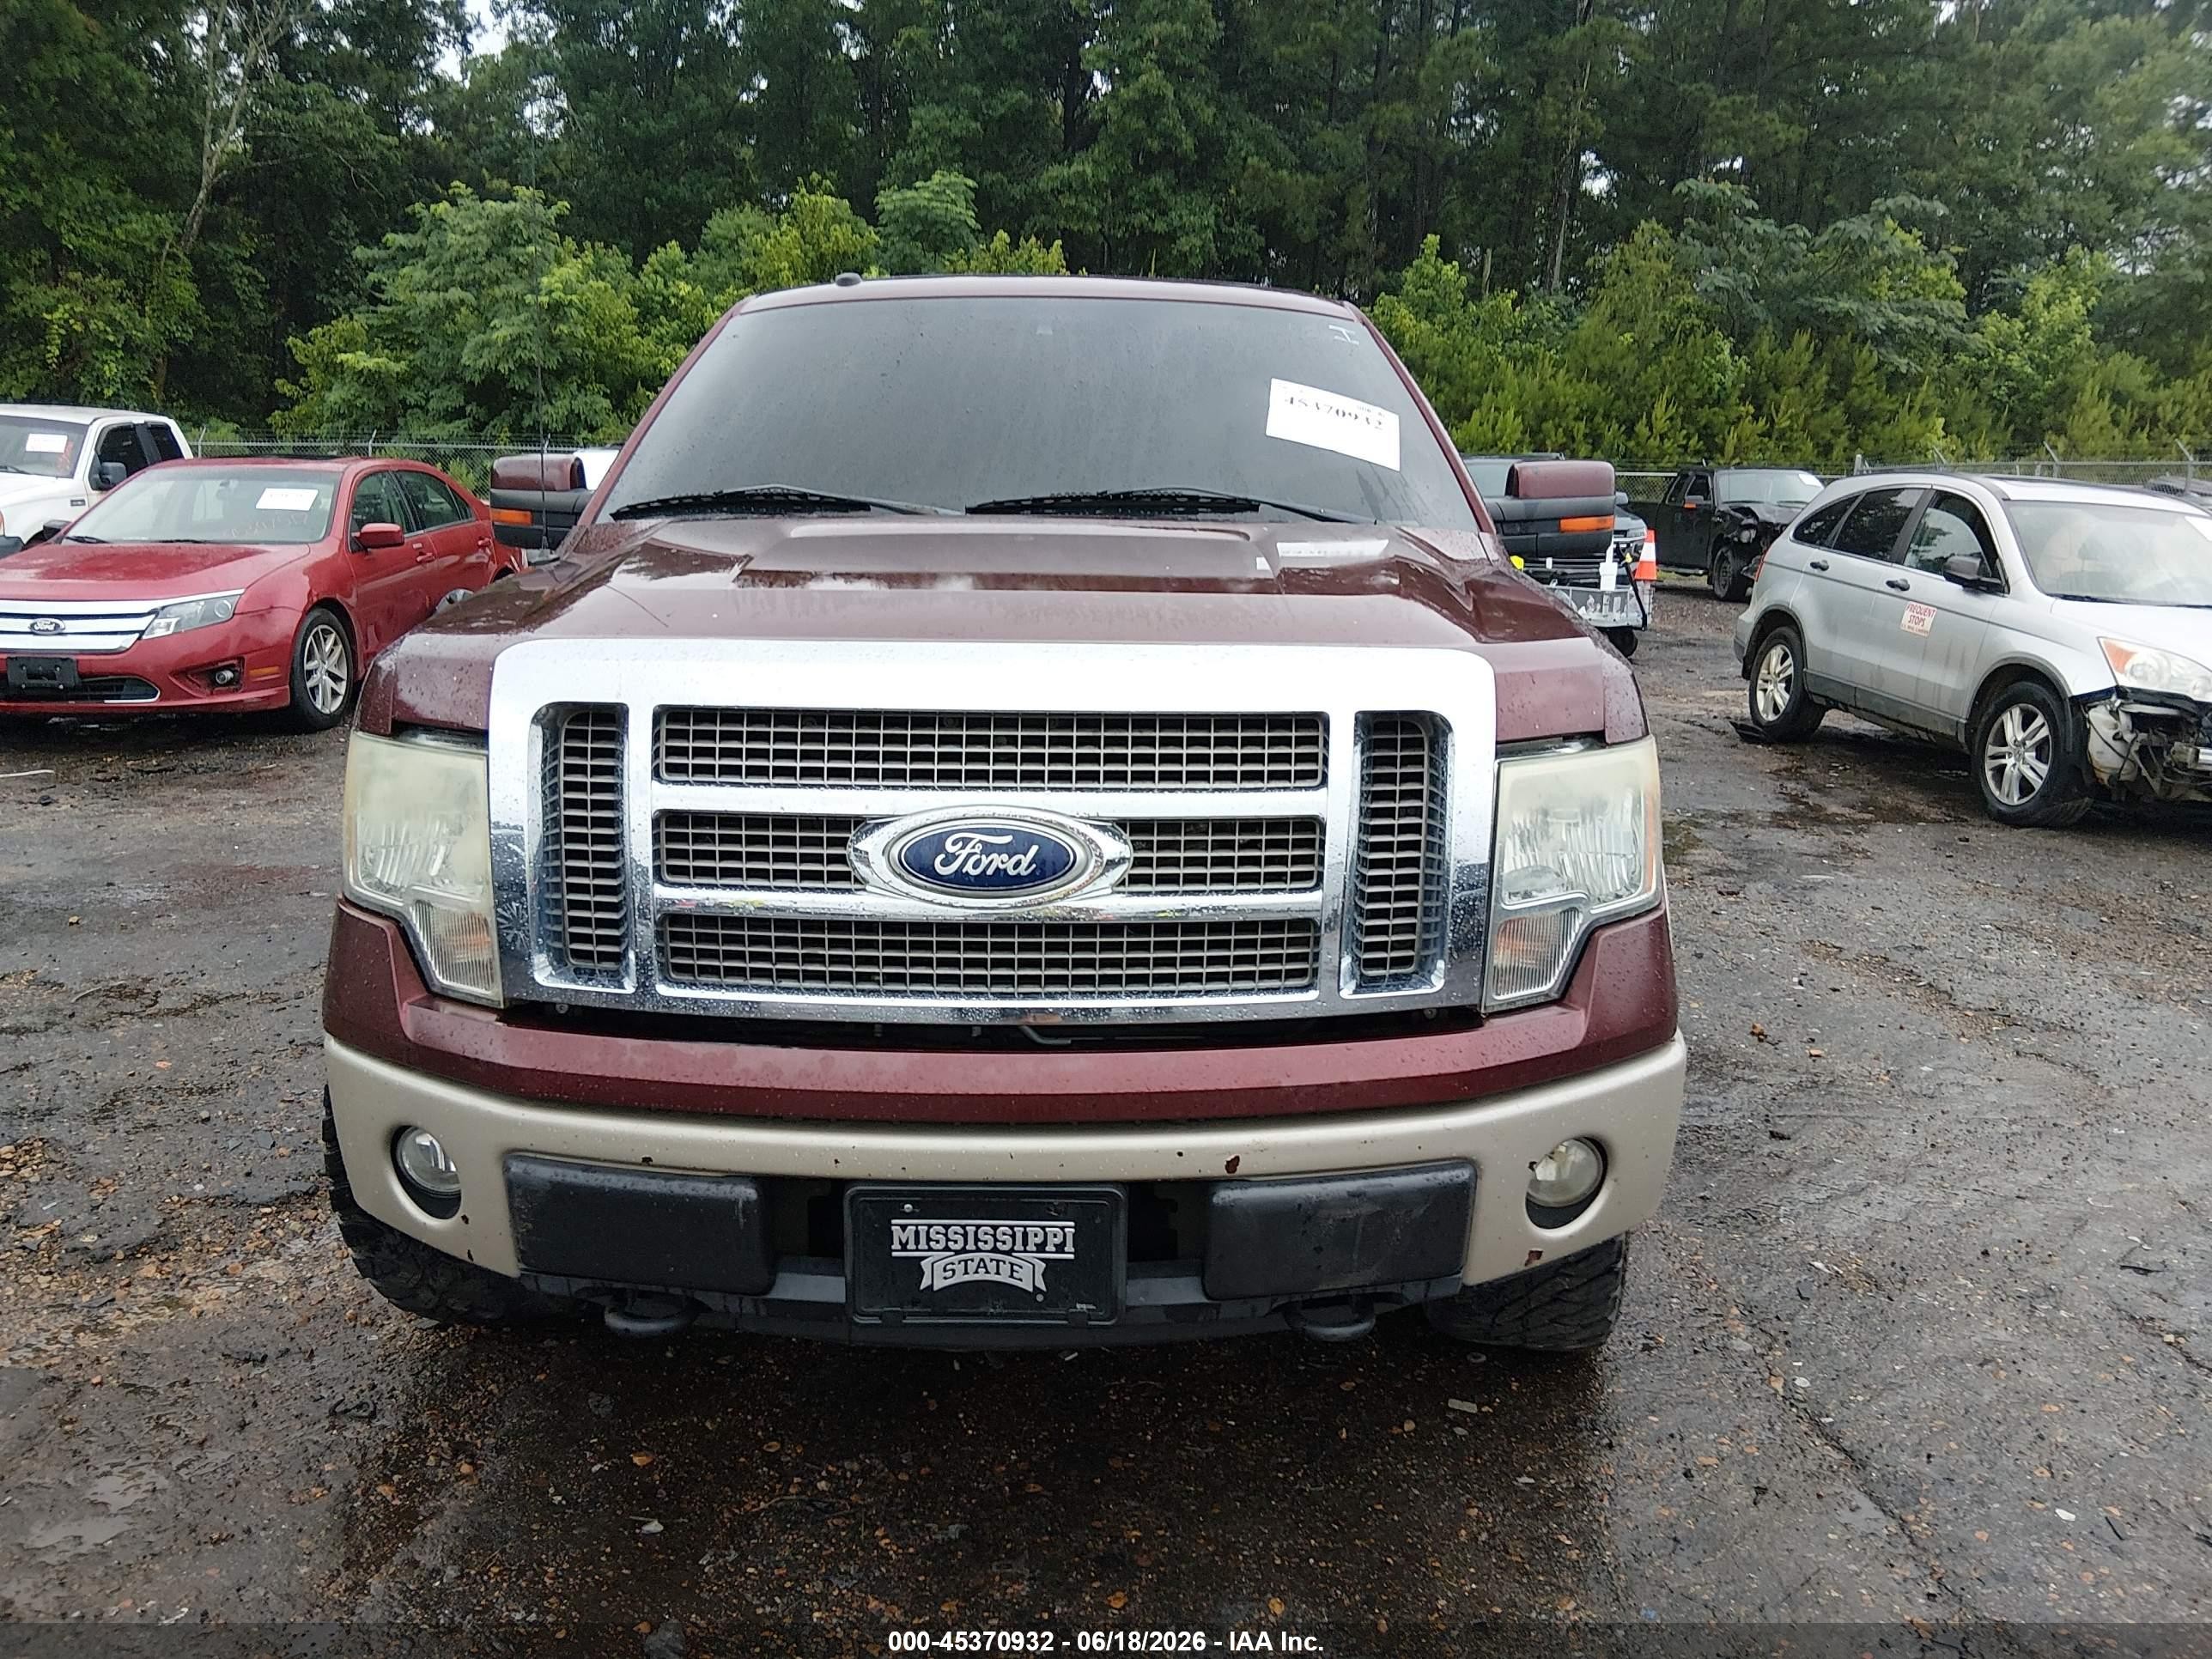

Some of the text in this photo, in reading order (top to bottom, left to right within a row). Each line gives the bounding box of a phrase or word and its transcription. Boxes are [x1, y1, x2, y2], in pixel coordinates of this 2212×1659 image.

[1906, 604, 1936, 617] FREQUENT
[1908, 614, 1926, 627] STOPS
[933, 832, 1038, 877] Ford
[890, 1225, 1075, 1254] MISSISSIPPI
[942, 1256, 1024, 1283] STATE
